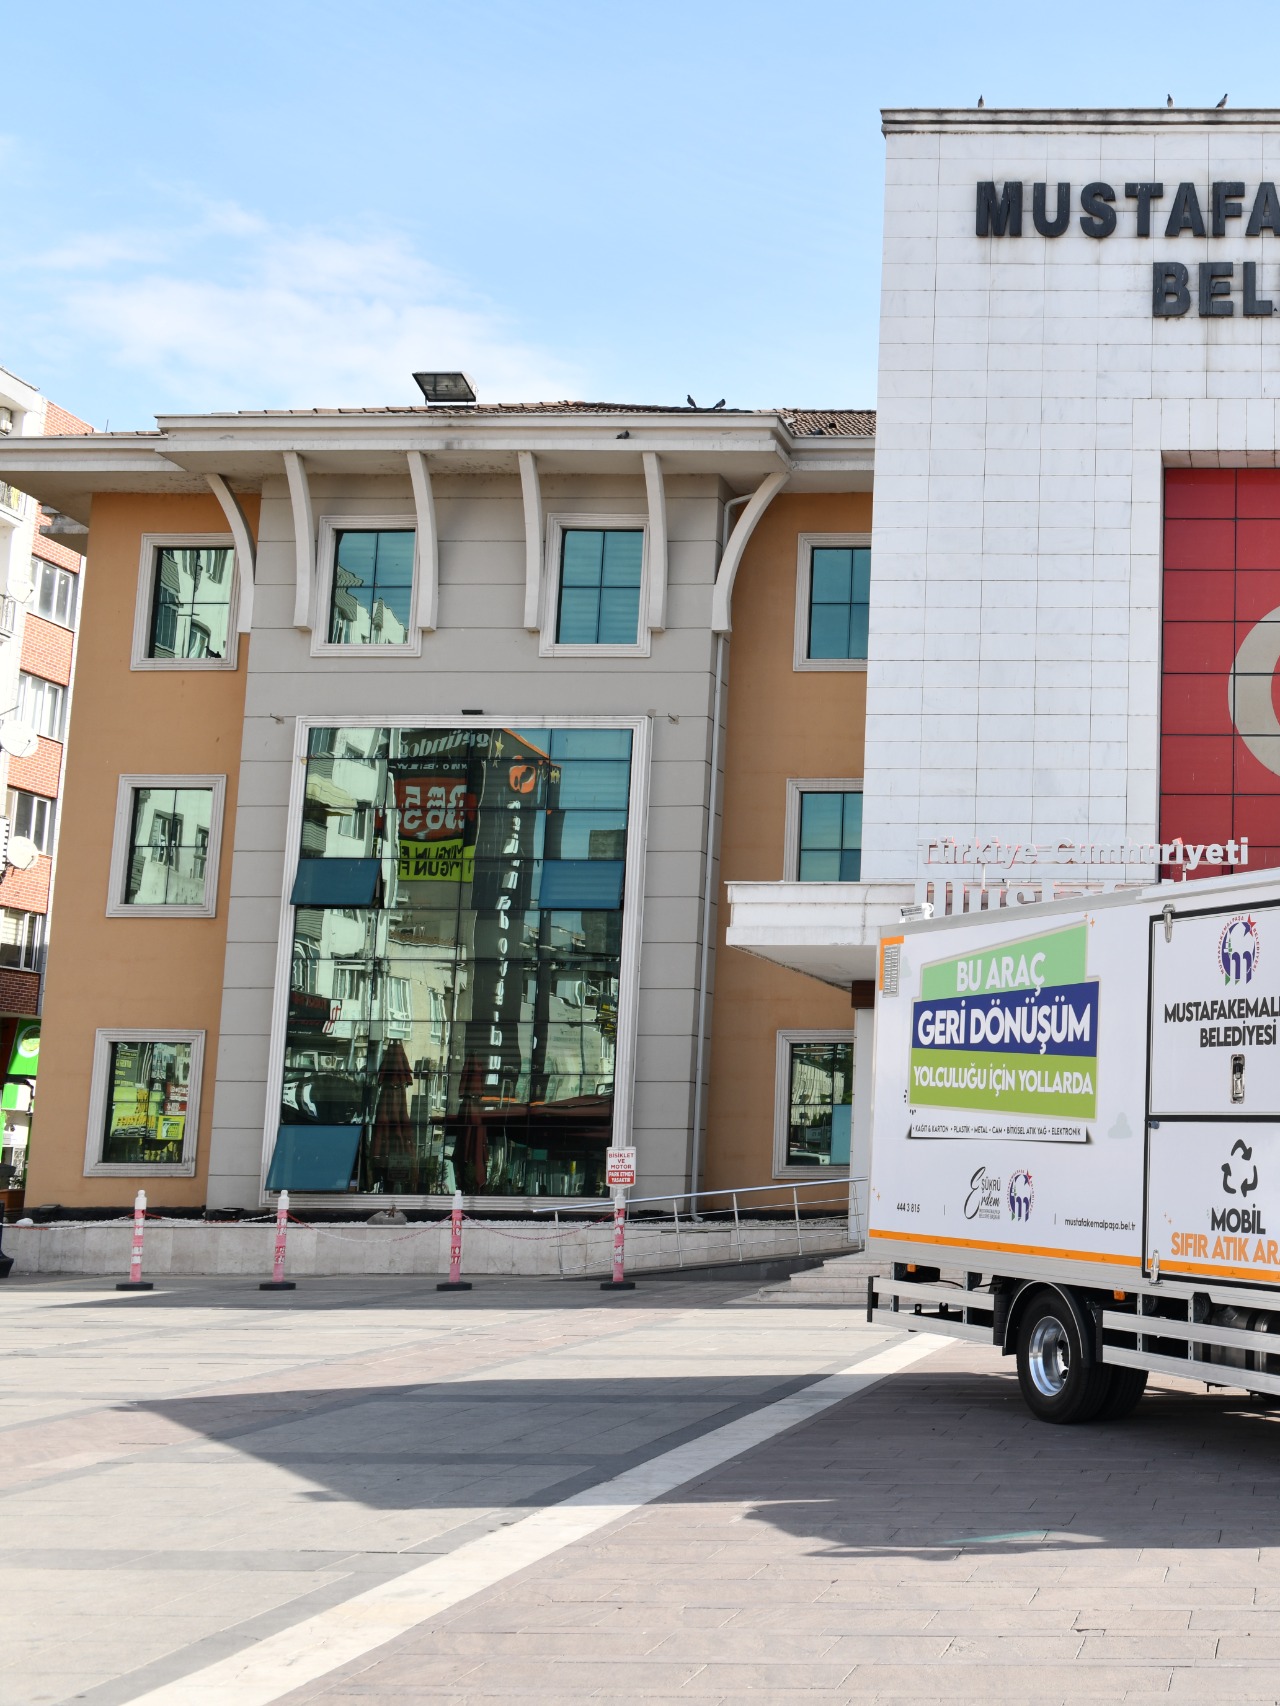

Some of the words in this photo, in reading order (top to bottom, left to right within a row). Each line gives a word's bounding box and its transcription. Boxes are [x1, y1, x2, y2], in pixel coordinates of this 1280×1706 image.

[916, 836, 1036, 869] Türkiye
[1052, 836, 1249, 871] Cumhuriyeti
[956, 959, 982, 992] BU
[985, 952, 1046, 997] ARAÇ
[917, 999, 966, 1046] GERİ
[969, 995, 1091, 1055] DÖNÜŞÜM
[1200, 1018, 1277, 1048] BELEDİYESİ
[913, 1062, 987, 1090] YOLCULUĞU
[988, 1063, 1016, 1097] İÇİN
[1018, 1069, 1094, 1095] YOLLARDA
[953, 1125, 970, 1133] PLASTİK
[973, 1126, 987, 1134] METAL
[991, 1126, 1003, 1134] CAM
[1006, 1125, 1025, 1135] BİTKİSEL
[1026, 1126, 1037, 1135] ATIK
[981, 1176, 1001, 1193] ŞÜKRÜ
[897, 1202, 905, 1211] 444
[911, 1203, 920, 1213] 815
[1211, 1203, 1266, 1235] MOBİL
[1064, 1217, 1136, 1231] mustafakemalpaşa.bel.tr
[1171, 1231, 1208, 1259] SIFIR
[1211, 1235, 1249, 1262] ATIK
